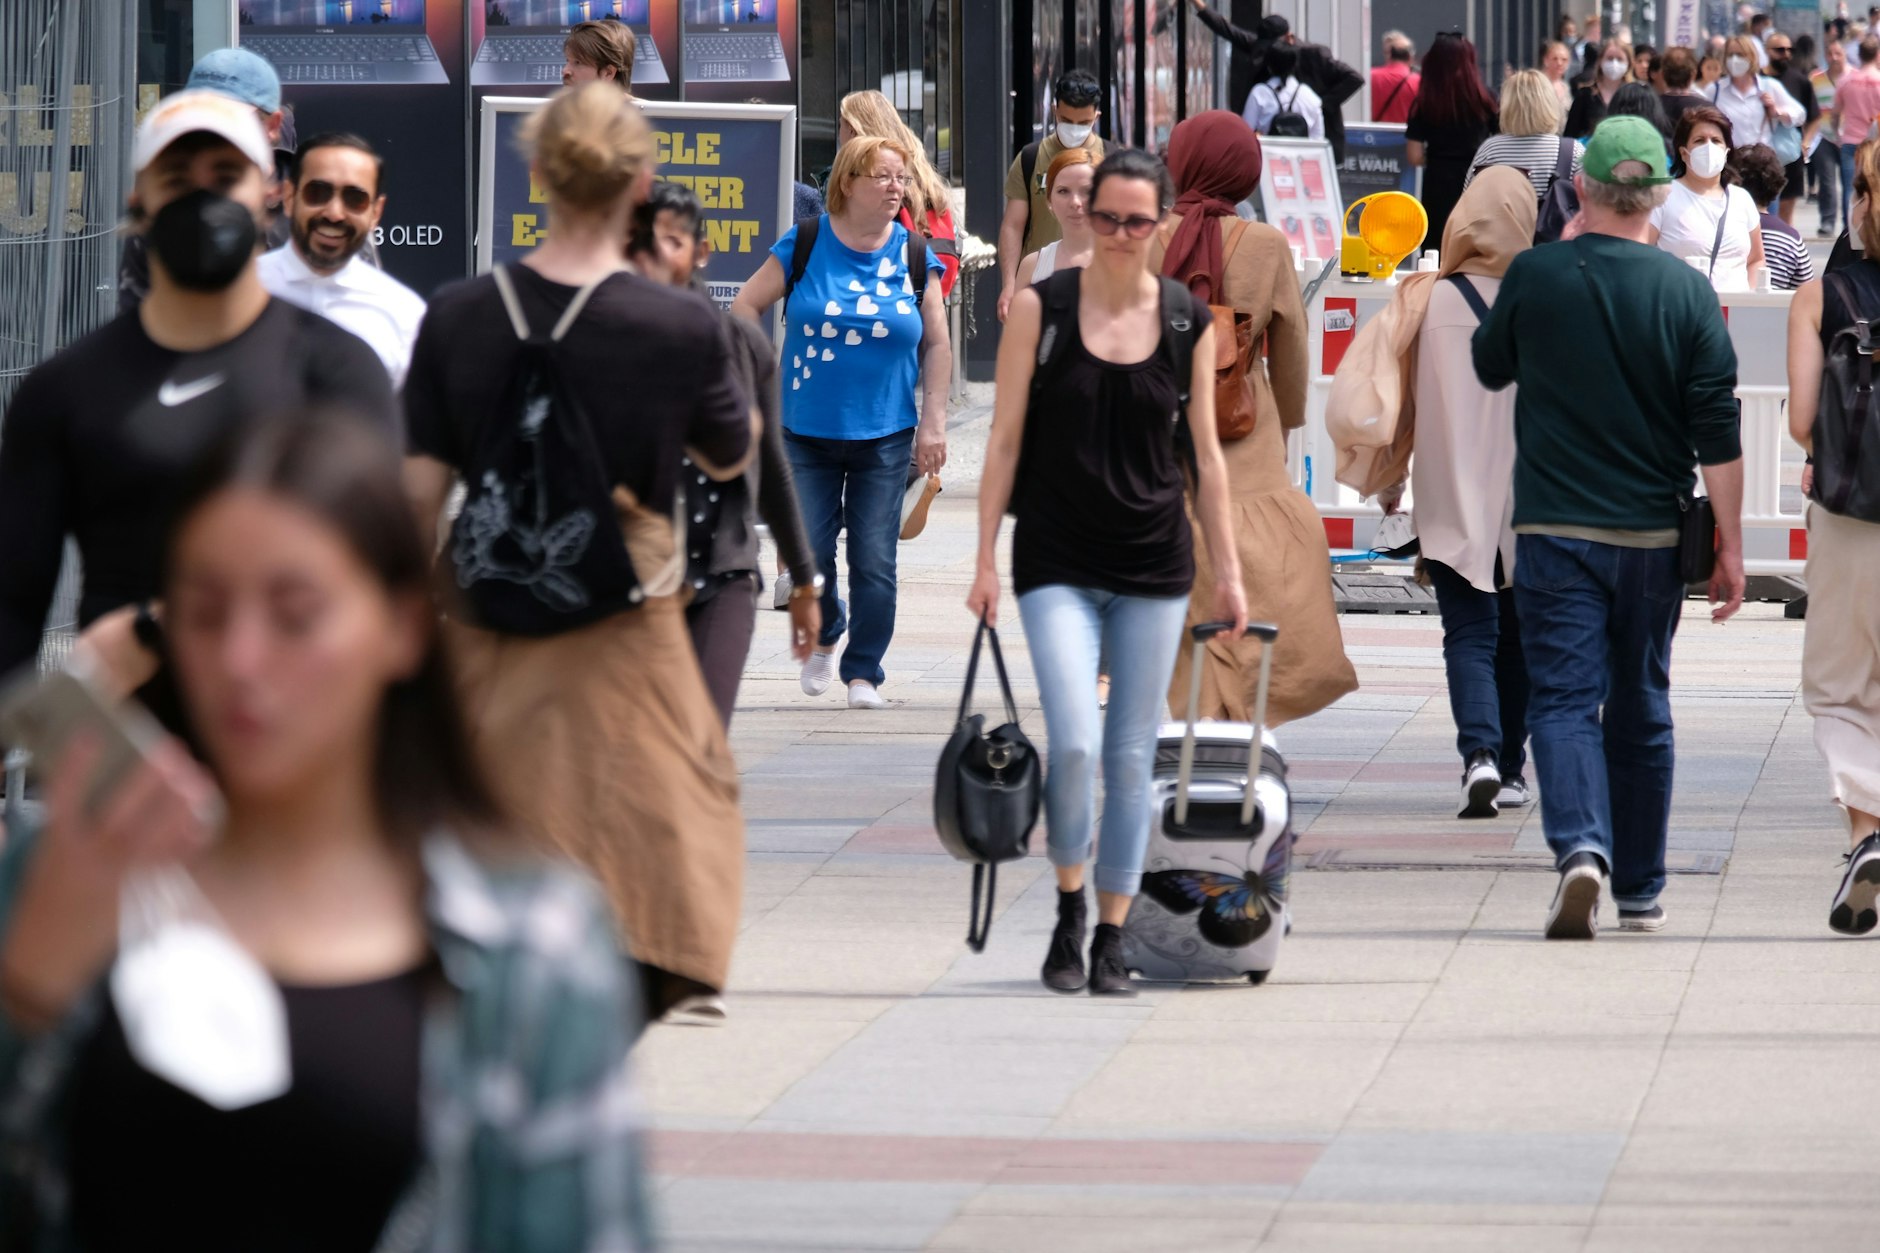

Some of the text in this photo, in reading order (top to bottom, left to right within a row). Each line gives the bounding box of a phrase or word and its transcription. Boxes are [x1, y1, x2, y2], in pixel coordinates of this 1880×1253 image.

[1676, 0, 1692, 45] BIRK
[650, 131, 720, 165] CLE
[1358, 157, 1401, 173] WAHL
[389, 225, 443, 246] OLED
[702, 220, 759, 253] NT
[707, 286, 741, 297] OURS
